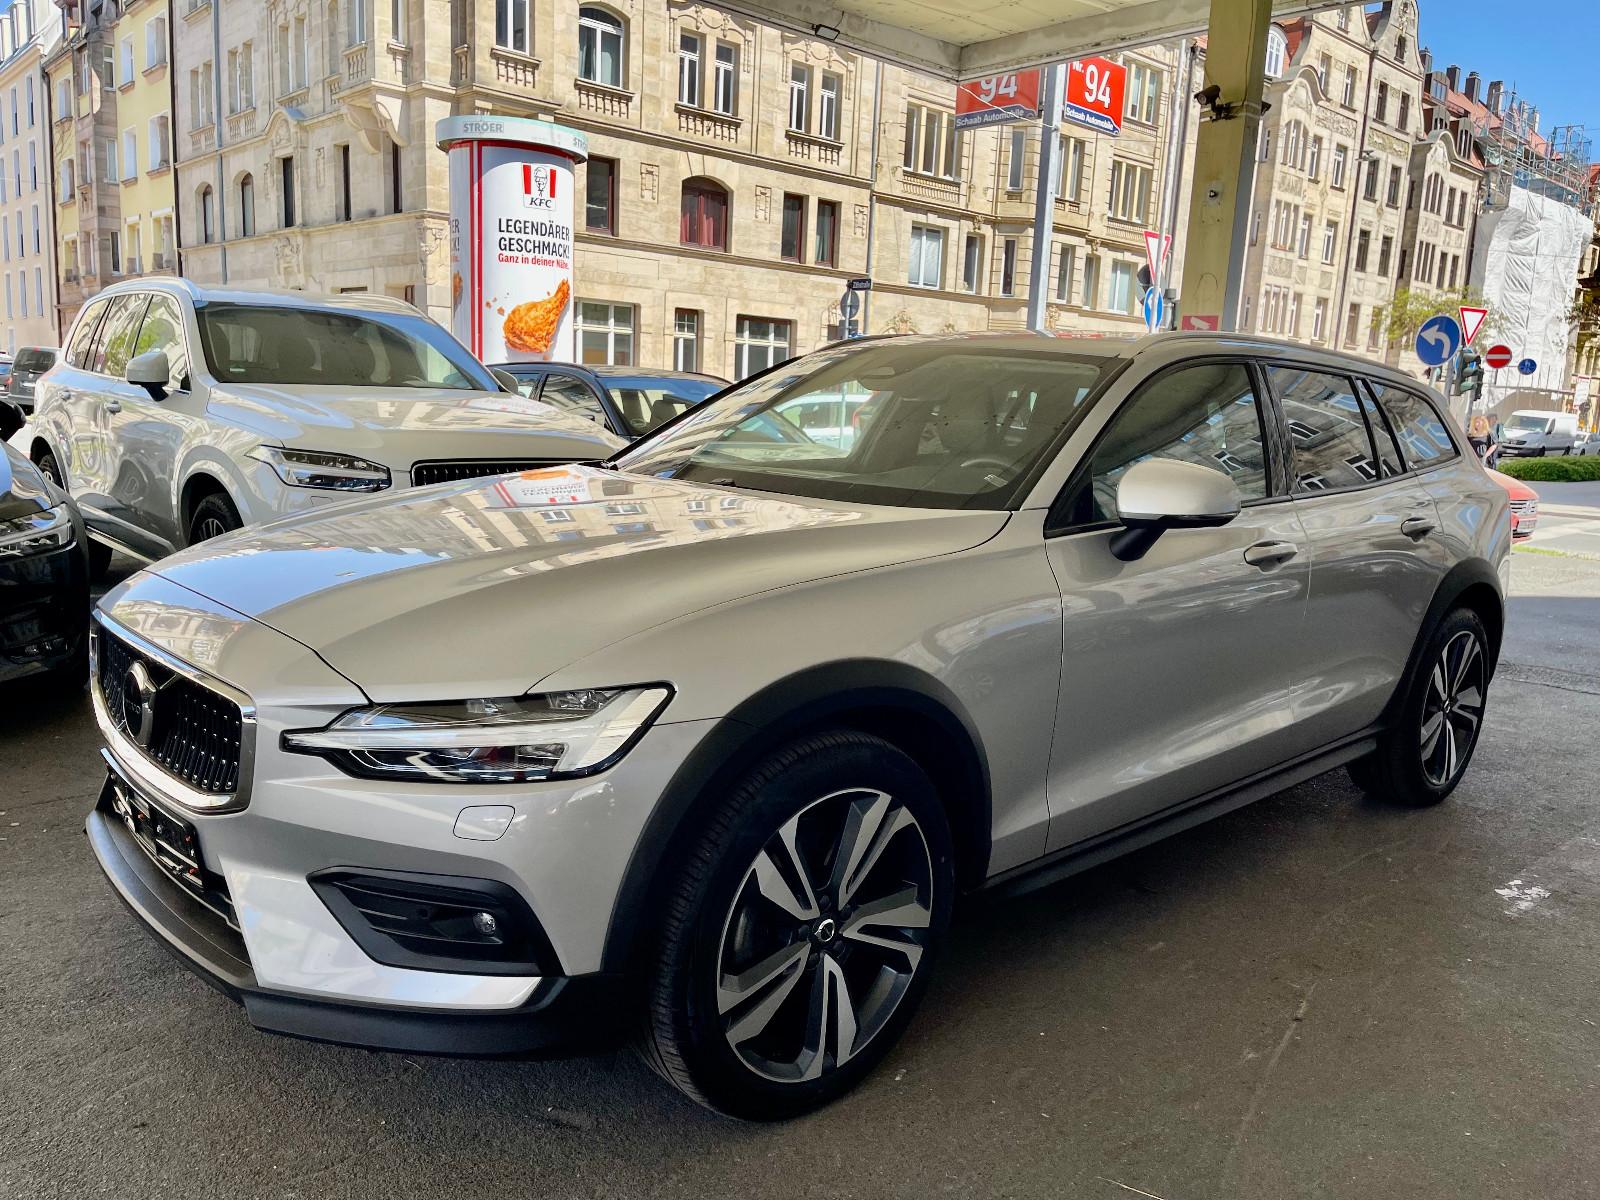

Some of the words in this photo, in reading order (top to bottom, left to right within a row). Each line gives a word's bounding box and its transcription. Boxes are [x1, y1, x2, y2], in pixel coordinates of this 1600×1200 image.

[980, 75, 1018, 103] 94
[1072, 61, 1085, 73] Nr.
[1085, 64, 1111, 109] 94
[463, 121, 503, 133] STRÖER
[956, 116, 982, 127] Schaab
[983, 108, 1025, 122] Automobile
[1066, 107, 1086, 121] Schaab
[1086, 113, 1114, 131] Automobile
[529, 197, 552, 208] KFC
[498, 217, 570, 241] LEGENDÄRER
[498, 236, 570, 259] GESCHMACK!
[498, 253, 519, 263] Ganz
[521, 254, 529, 264] in
[531, 255, 555, 267] deiner
[556, 259, 569, 269] Nähe.
